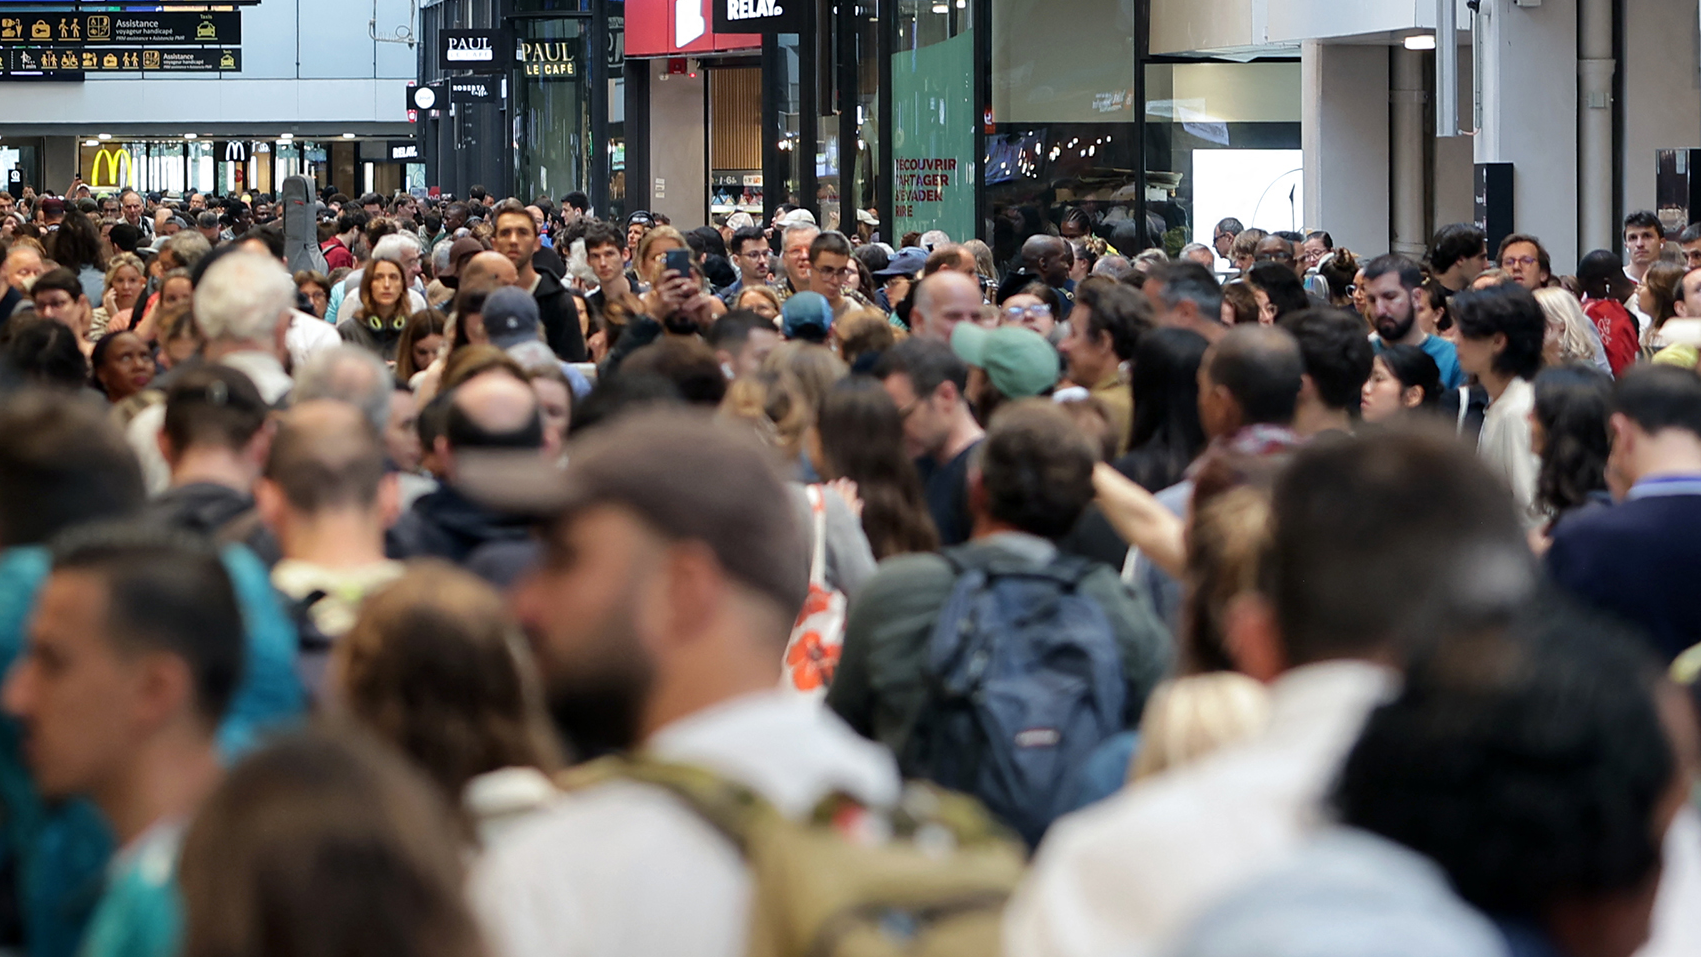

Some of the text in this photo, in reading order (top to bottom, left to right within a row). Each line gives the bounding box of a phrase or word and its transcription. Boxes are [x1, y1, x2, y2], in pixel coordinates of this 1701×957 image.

[116, 19, 158, 28] Assistance
[447, 36, 493, 50] PAUL
[521, 42, 575, 62] PAUL
[526, 63, 540, 75] LE
